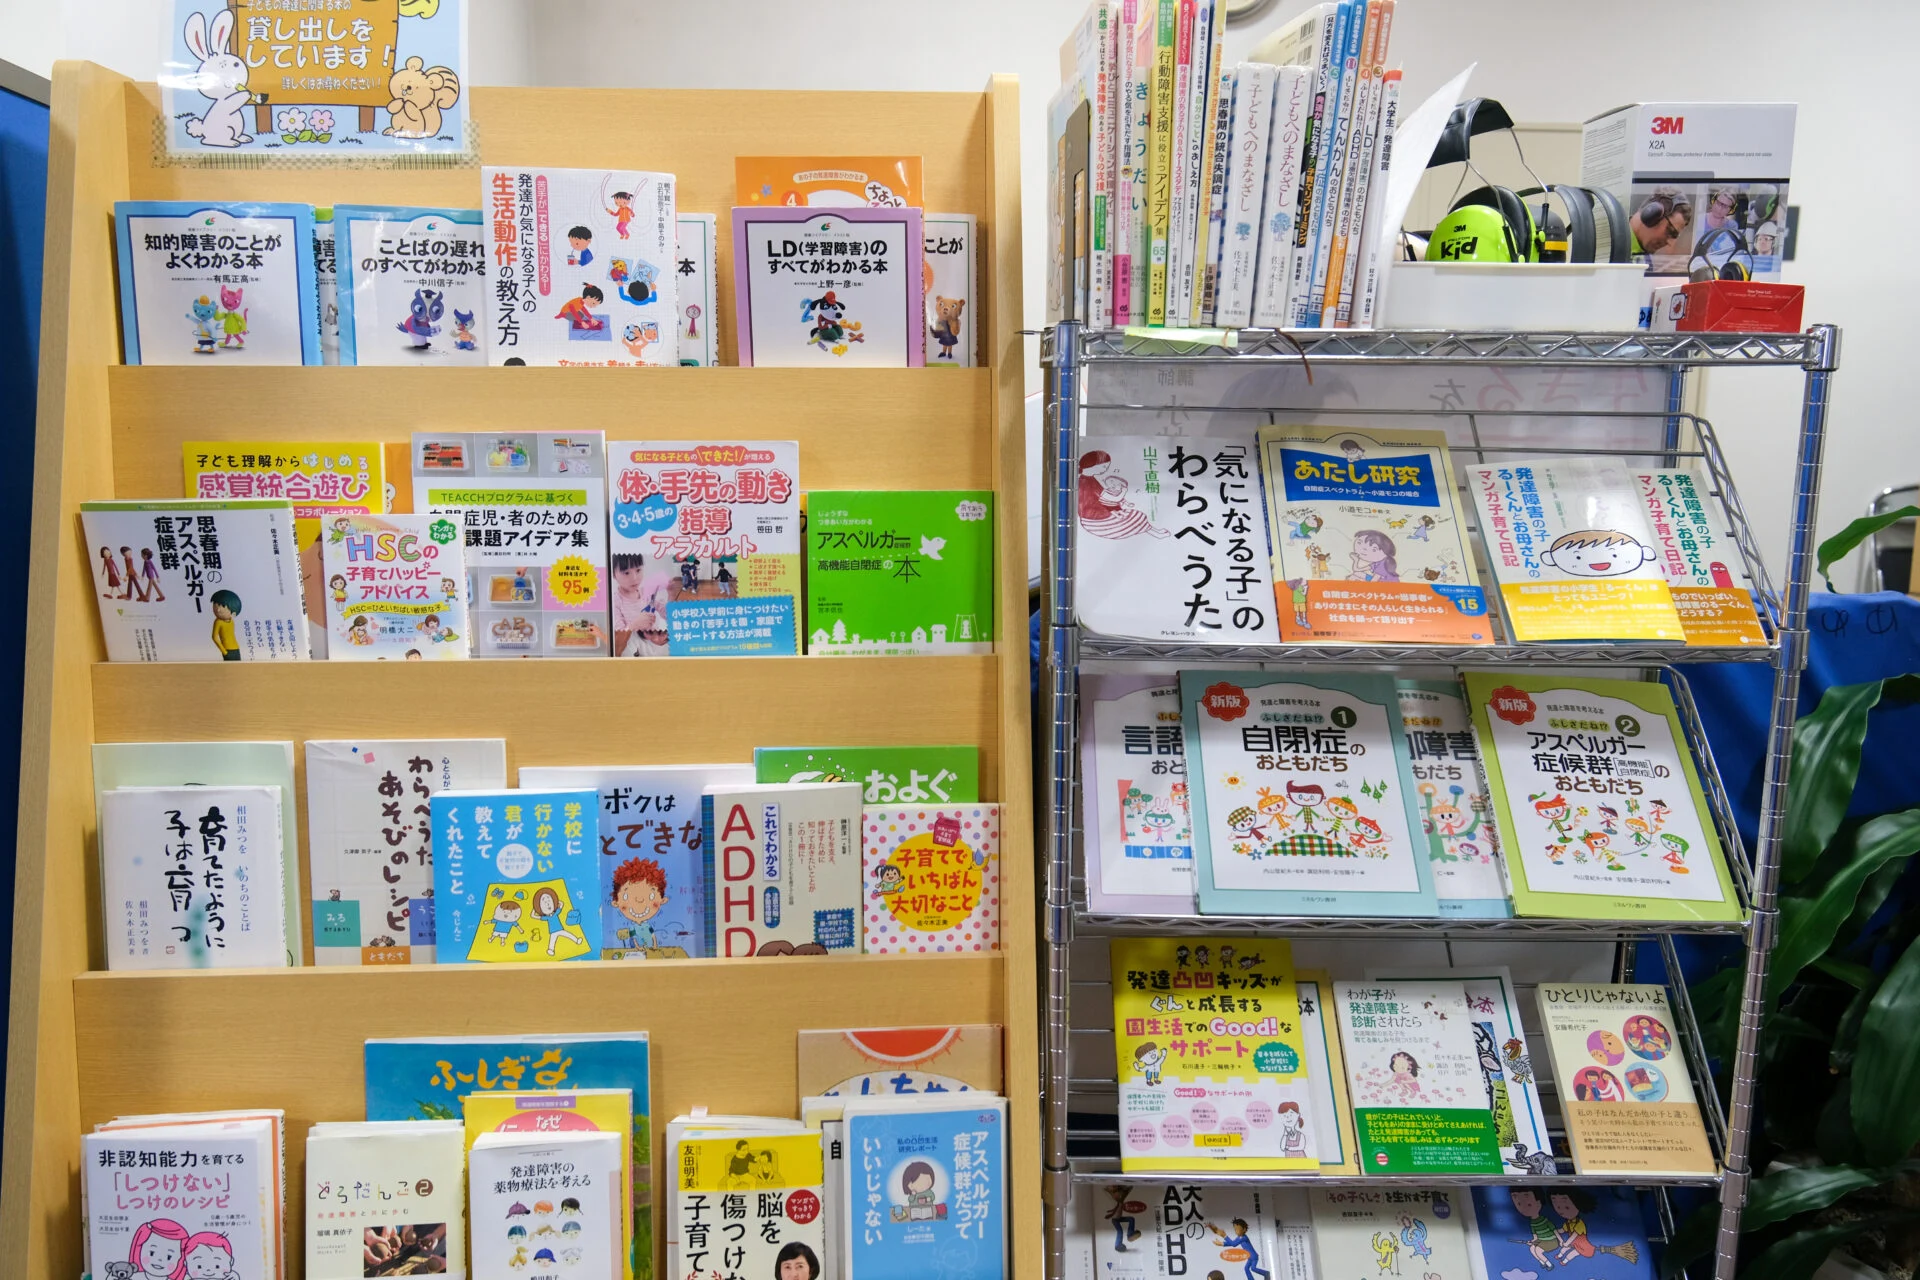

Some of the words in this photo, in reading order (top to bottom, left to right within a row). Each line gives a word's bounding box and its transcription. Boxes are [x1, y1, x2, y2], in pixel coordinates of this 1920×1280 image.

[247, 16, 374, 42] 貸し出しを
[1651, 116, 1684, 135] 3M
[1649, 140, 1665, 149] X2A
[786, 193, 798, 207] 4
[144, 233, 282, 252] 知的障害のことが
[518, 173, 537, 313] 発達が気になる子への
[925, 238, 964, 254] ことが
[166, 253, 263, 270] よくわかる本
[362, 258, 486, 276] のすべてがわかる
[492, 173, 521, 346] 生活動作の教え方
[678, 258, 696, 276] 本
[768, 258, 888, 275] すべてがわかる本
[197, 454, 369, 470] 子ども理解からはじめる
[1143, 446, 1160, 494] 山下直樹
[1294, 459, 1421, 487] あたし研究
[198, 472, 370, 499] 感覚統合遊び
[441, 492, 574, 504] TEACCHプログラムに基づく
[618, 468, 792, 505] 体・手先の動き
[1515, 467, 1550, 542] 発達障害の子
[1674, 474, 1716, 549] 発達障害の子
[680, 507, 732, 534] 指導
[1478, 470, 1520, 567] マンガ子育て日記
[1498, 468, 1541, 579] るーくんとお母さんの
[1638, 475, 1687, 576] マンガ子育て日記
[1657, 475, 1710, 587] るーくんとお母さんの
[154, 516, 181, 570] 症候群
[197, 516, 223, 583] 思春期の
[346, 533, 439, 562] HSCの
[465, 530, 590, 548] 課題アイデア集
[651, 534, 757, 561] アラカルト
[817, 529, 911, 550] アスペルガー
[1168, 445, 1222, 629] わらべうた
[1213, 445, 1265, 631] 「気になる子」の
[175, 516, 205, 614] アスペルガー
[346, 562, 441, 582] 子育てハッピー
[360, 584, 430, 600] アドバイス
[1457, 598, 1480, 610] 15
[671, 604, 789, 618] 小学校入学前に身につけたい
[1210, 695, 1241, 708] 新版
[1498, 697, 1528, 712] 新版
[1620, 718, 1637, 736] 2
[1241, 726, 1366, 756] 自閉症の
[1526, 731, 1646, 755] アスペルガー
[1256, 755, 1348, 773] おともだち
[1412, 764, 1462, 780] もだち
[1532, 753, 1615, 776] 症候群
[864, 768, 958, 803] およぐ
[1555, 775, 1643, 796] おともだち
[408, 755, 434, 866] わらべうた
[603, 787, 676, 814] ボクは
[474, 806, 494, 859] 教えて
[504, 805, 523, 840] 君が
[564, 802, 583, 855] 学校に
[534, 803, 553, 873] 行かない
[764, 806, 779, 878] これでわかる
[378, 770, 411, 932] あそびのレシピ
[446, 807, 465, 895] くれたこと
[896, 848, 968, 868] 子育てで
[198, 806, 228, 948] 育てたように
[721, 803, 757, 958] ADHD
[908, 869, 977, 889] いちばん
[238, 865, 250, 932] いのちのことば
[892, 893, 973, 914] 大切なこと
[1127, 970, 1282, 990] 発達凸凹キッズが
[1150, 994, 1262, 1013] ぐんと成長する
[1347, 988, 1396, 1001] わが子が
[1545, 988, 1665, 1005] ひとりじゃないよ
[1349, 1001, 1411, 1015] 発達障害と
[1351, 1015, 1422, 1029] 診断されたら
[1170, 1038, 1249, 1058] サポート
[535, 1114, 562, 1129] なぜ
[98, 1150, 245, 1168] 非認知能力を育てる
[510, 1162, 574, 1178] 発達障害の
[684, 1145, 696, 1189] 友田明美
[114, 1171, 231, 1193] 「しつけない」
[317, 1181, 410, 1204] どろだんご
[493, 1174, 592, 1194] 薬物療法を考える
[863, 1136, 884, 1245] いいじゃない
[953, 1132, 972, 1239] 症候群だって
[972, 1131, 990, 1239] アスペルガー
[117, 1195, 231, 1210] しつけのレシピ
[1183, 1185, 1205, 1240] 大人の
[757, 1192, 783, 1244] 脳を
[684, 1195, 711, 1272] 子育て
